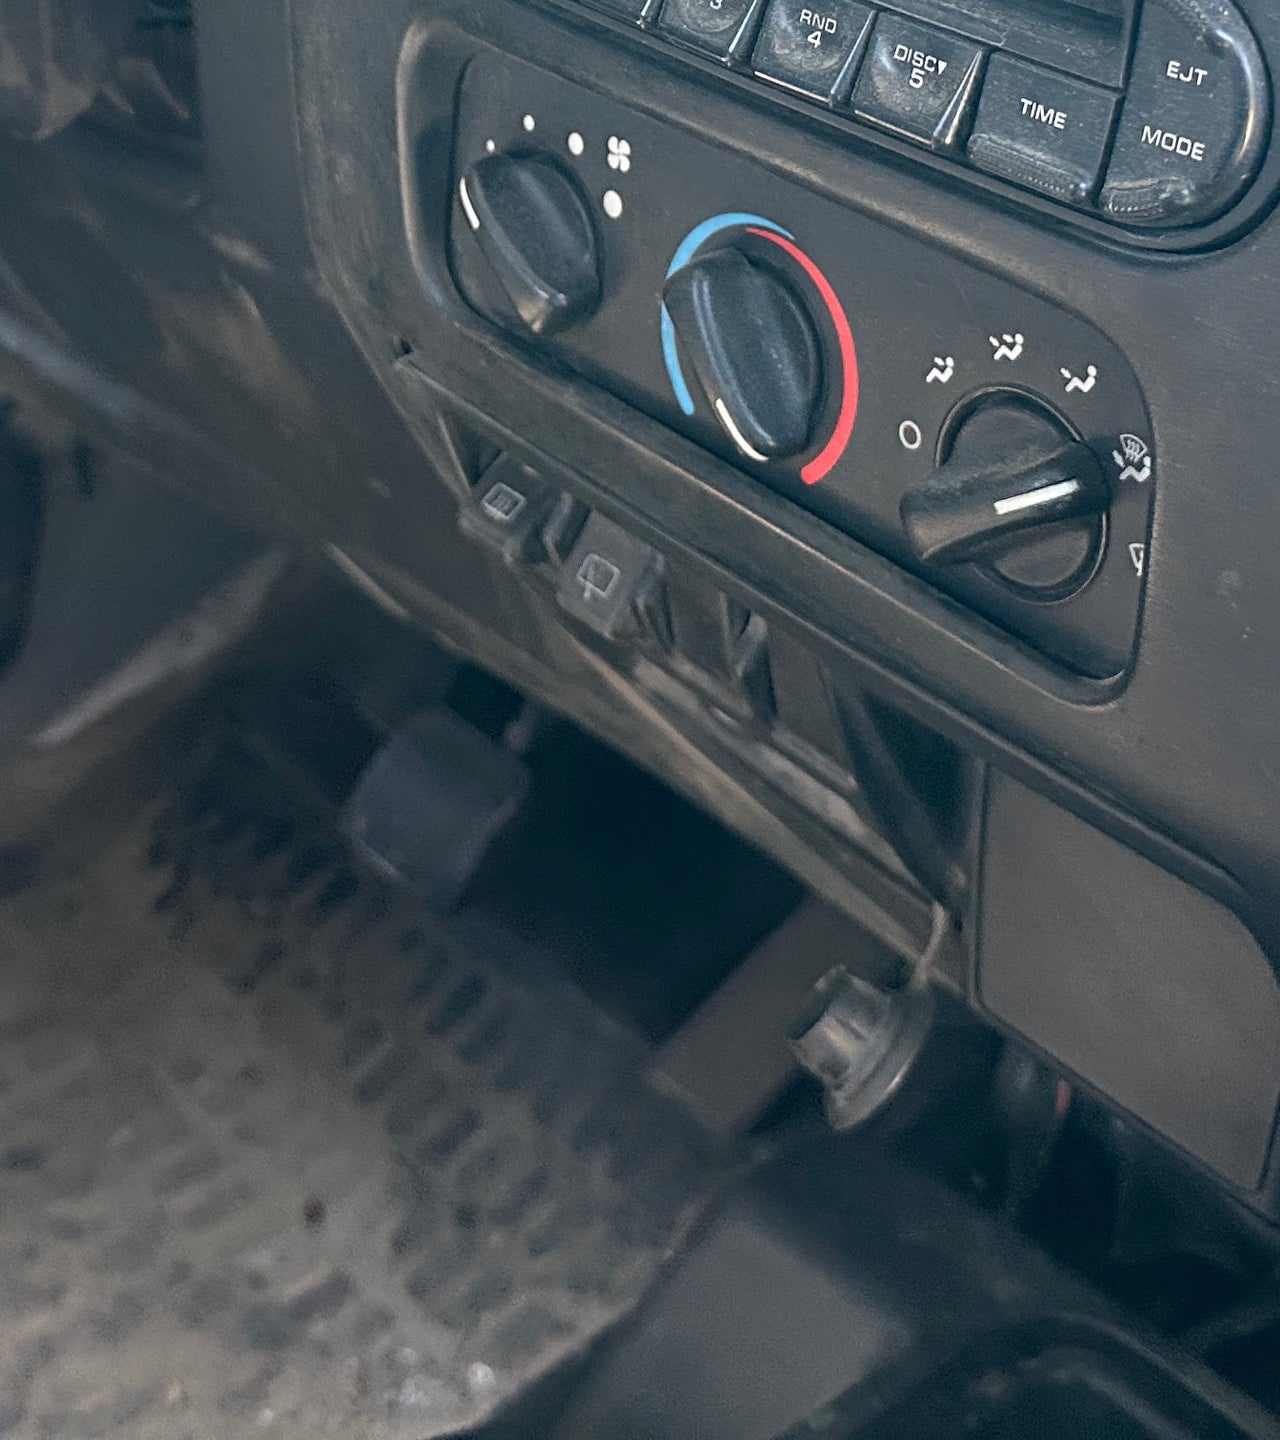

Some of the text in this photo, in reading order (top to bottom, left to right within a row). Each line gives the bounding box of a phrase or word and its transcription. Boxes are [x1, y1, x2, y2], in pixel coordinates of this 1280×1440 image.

[800, 8, 837, 34] RND
[807, 31, 822, 49] 4
[893, 44, 938, 74] DISC
[909, 70, 924, 90] 5
[1166, 60, 1208, 87] EJT
[1020, 97, 1067, 130] TIME
[1141, 125, 1206, 161] MODE
